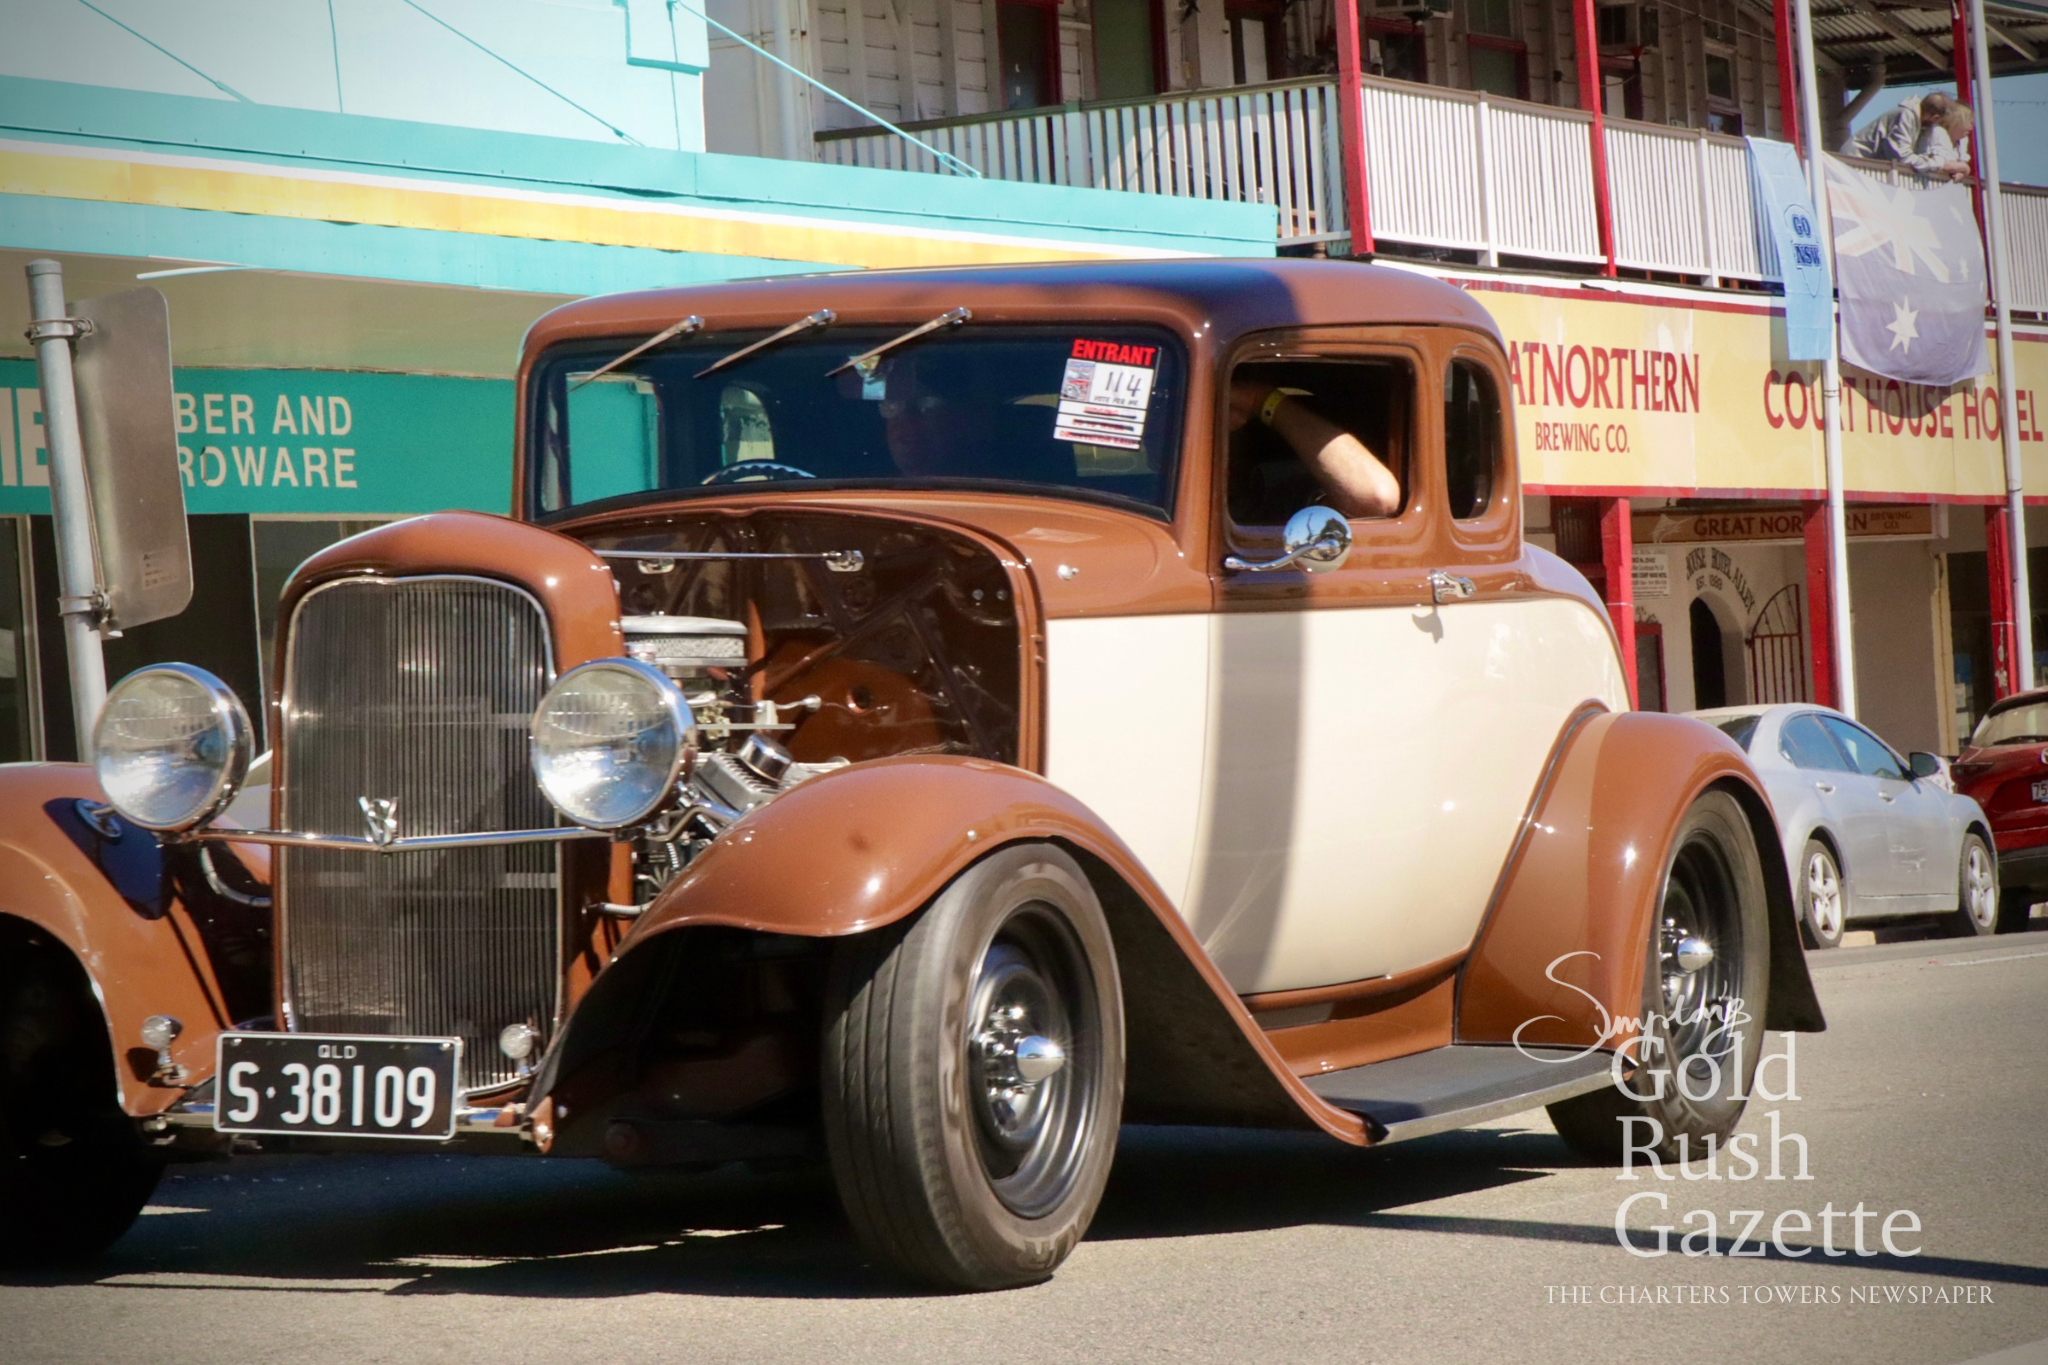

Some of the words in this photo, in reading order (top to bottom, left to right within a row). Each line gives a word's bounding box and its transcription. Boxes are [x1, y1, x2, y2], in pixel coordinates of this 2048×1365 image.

[1792, 214, 1811, 238] GO
[1794, 245, 1820, 265] NSW
[1071, 338, 1157, 367] ENTRANT
[1104, 371, 1142, 398] 114
[272, 394, 352, 435] AND
[1865, 377, 1954, 439] HOUSE
[1963, 386, 2044, 442] HOEL
[1535, 422, 1600, 453] BREWING
[1605, 424, 1630, 453] CO.
[1694, 516, 1758, 536] GREAT
[1870, 511, 1912, 521] BREWING
[1732, 566, 1756, 615] ALLEY
[317, 1044, 358, 1059] QLD
